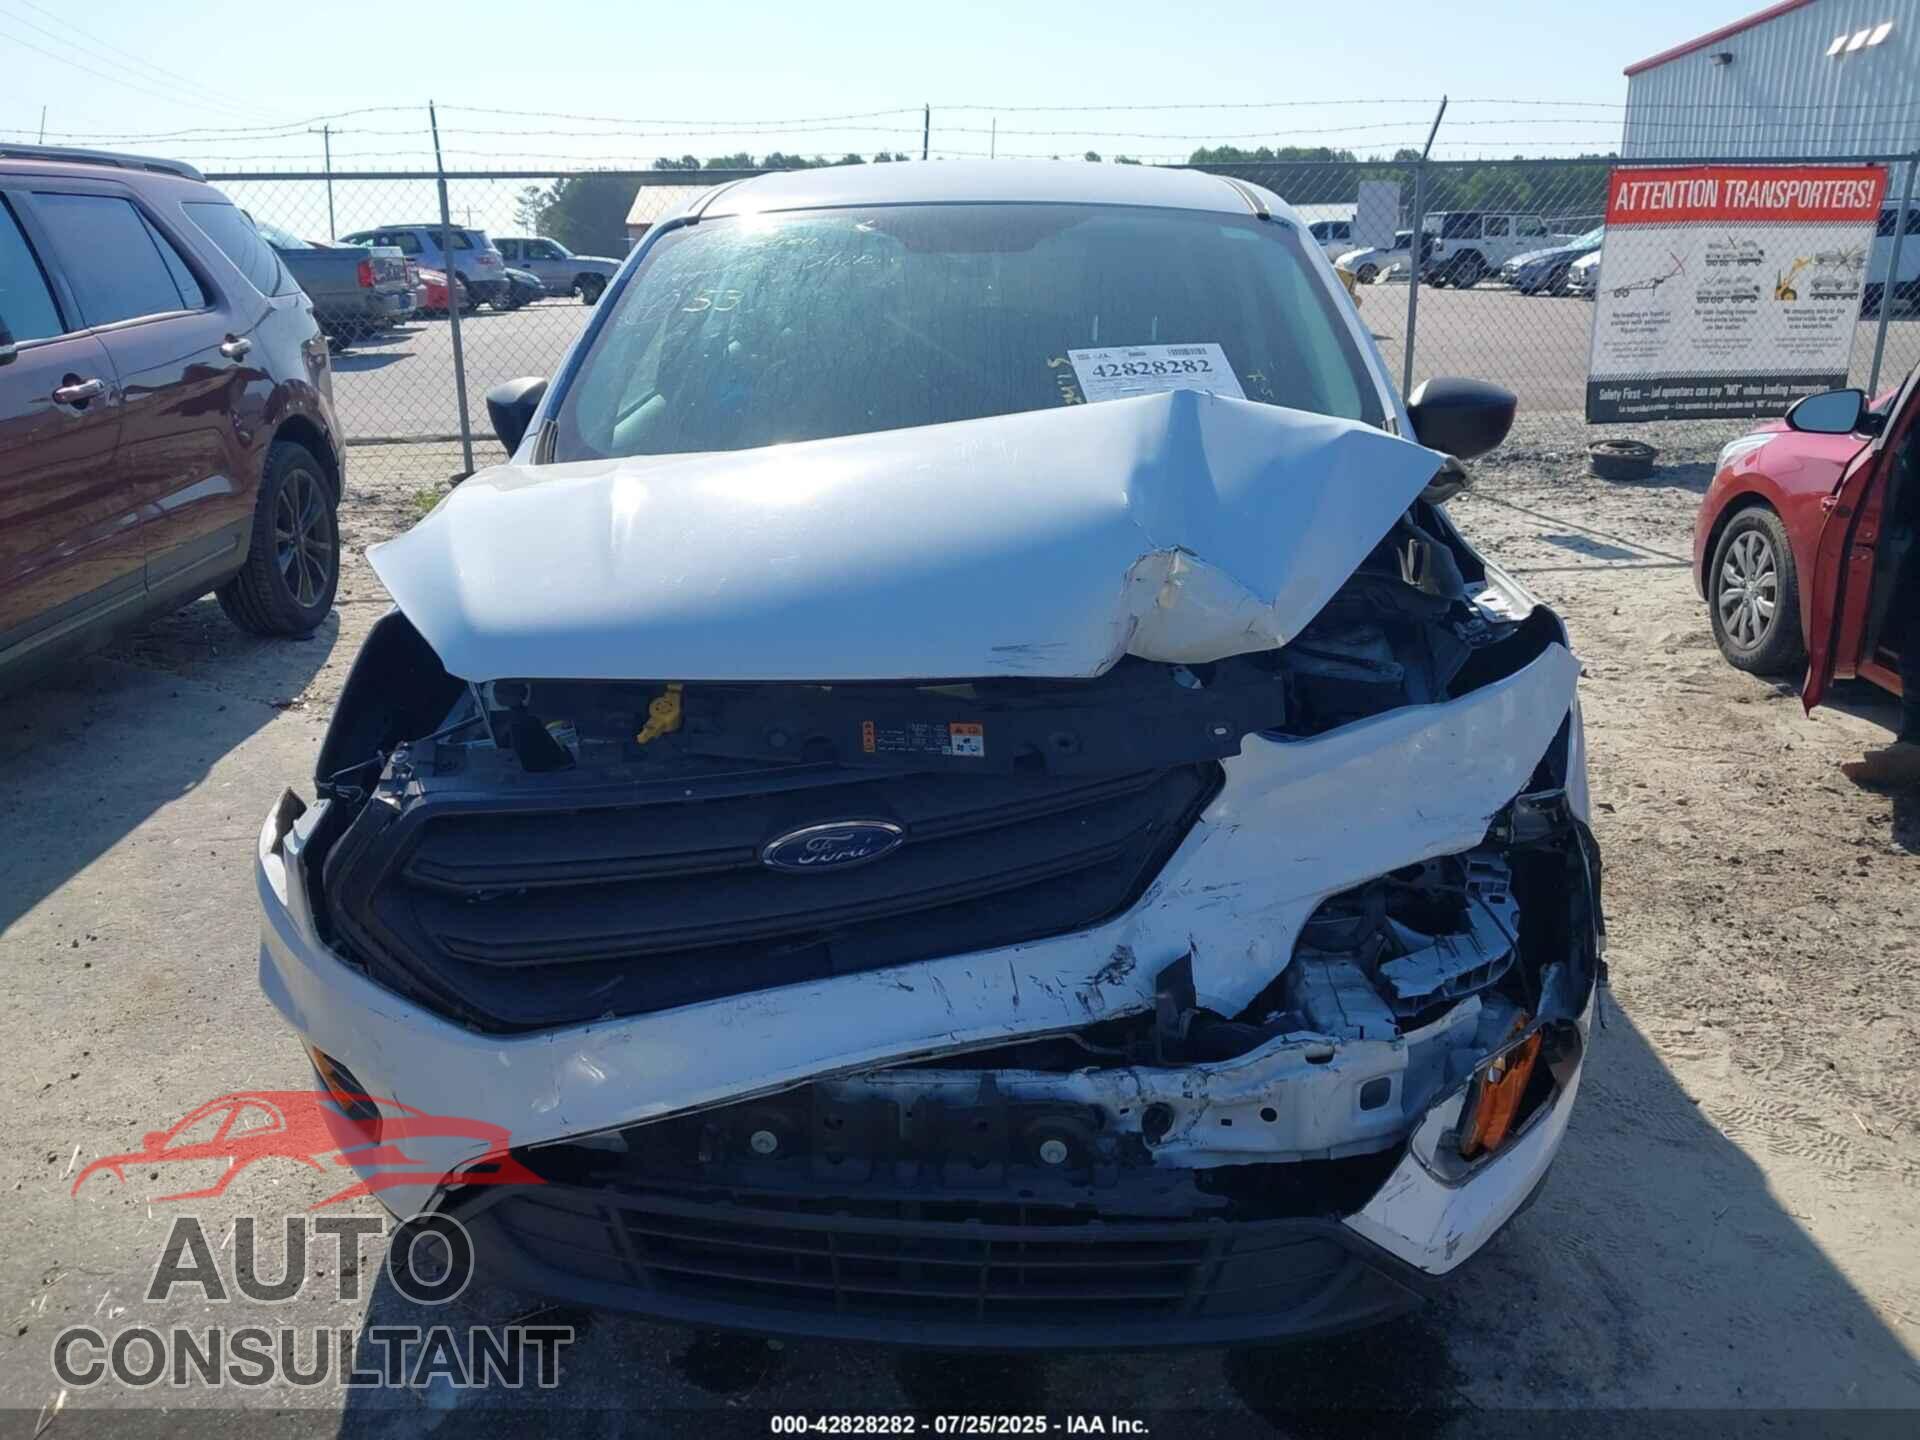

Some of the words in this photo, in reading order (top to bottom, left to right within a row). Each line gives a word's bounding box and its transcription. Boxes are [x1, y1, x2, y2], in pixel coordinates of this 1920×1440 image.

[1615, 180, 1719, 212] ATTENTION
[1724, 179, 1876, 210] TRANSPORTERS!
[1092, 359, 1213, 378] 42828282
[1600, 387, 1621, 402] Safety
[1623, 387, 1641, 400] First
[798, 834, 872, 863] Ford
